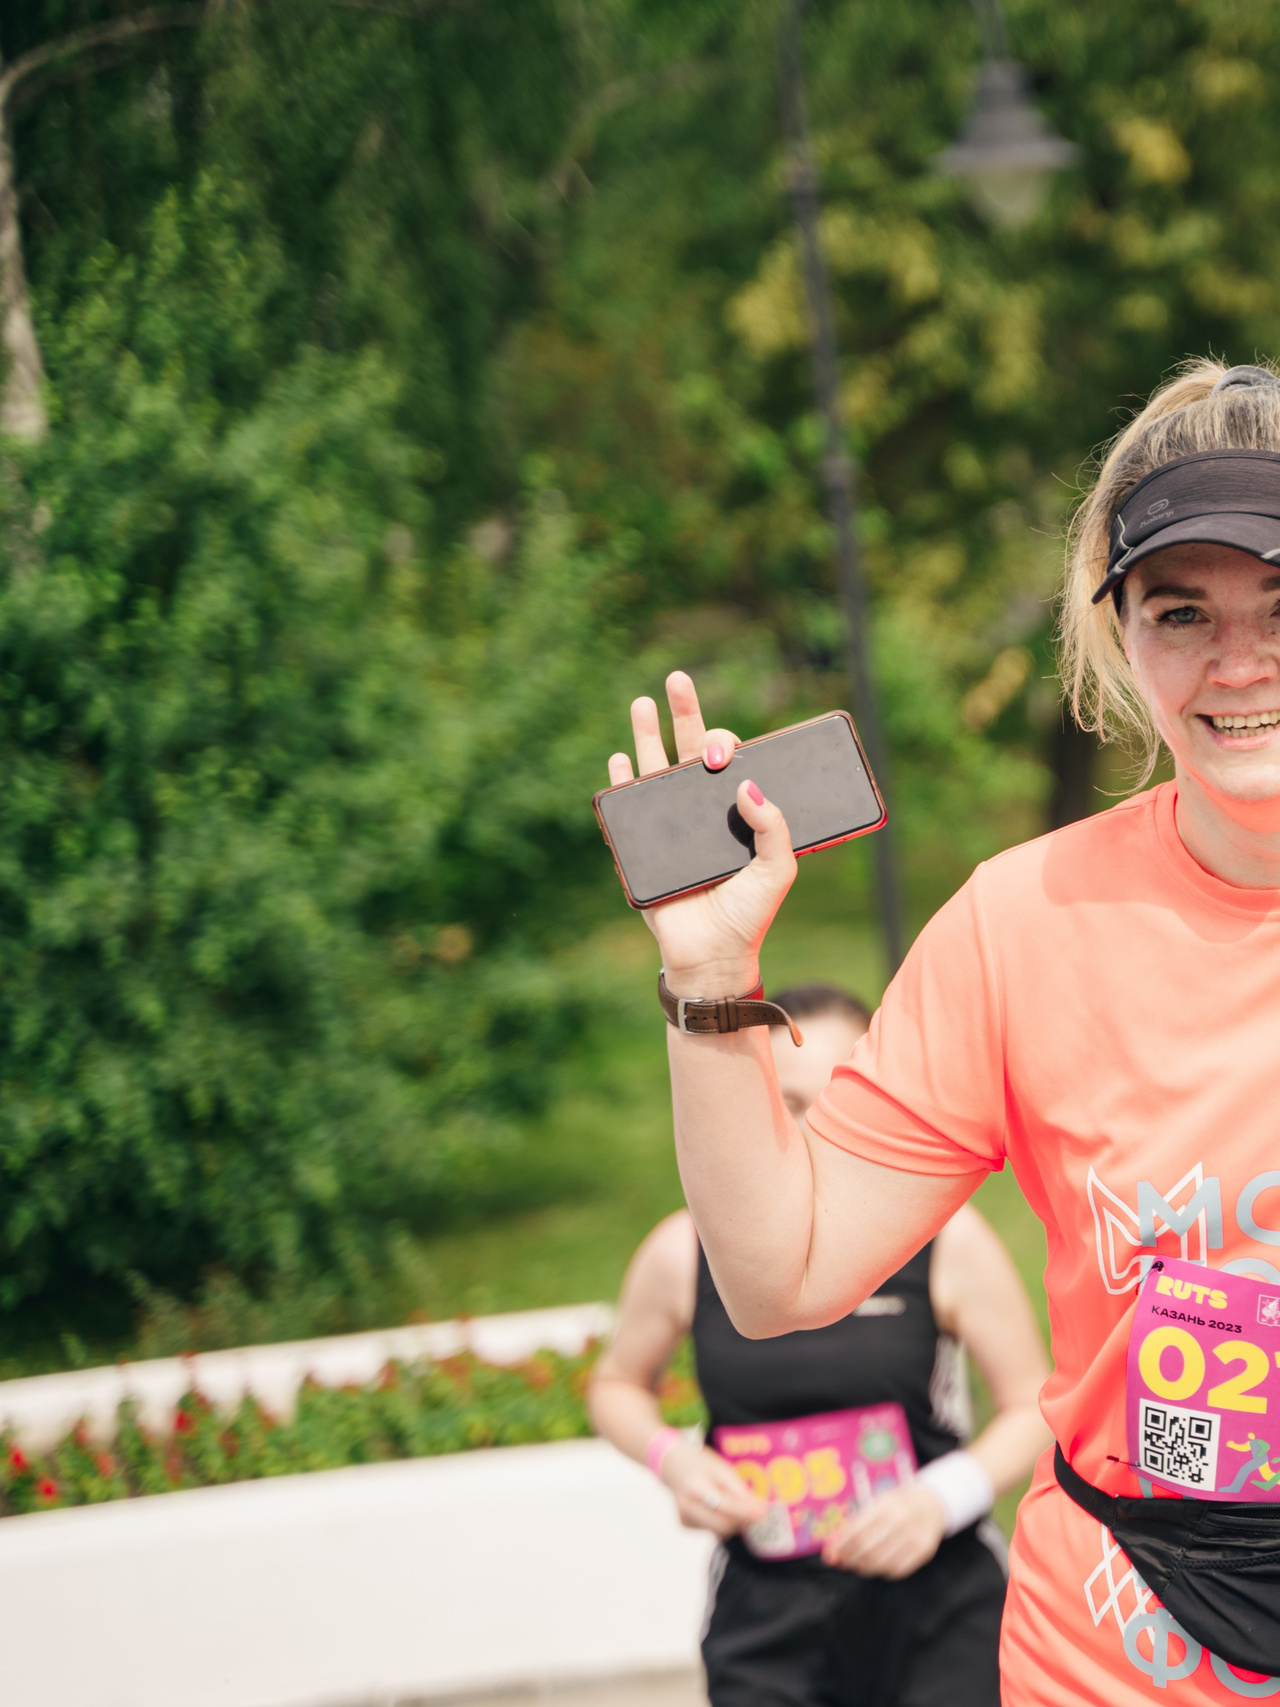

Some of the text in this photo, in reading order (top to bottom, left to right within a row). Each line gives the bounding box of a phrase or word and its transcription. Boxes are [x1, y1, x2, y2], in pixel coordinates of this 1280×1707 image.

[1155, 1275, 1228, 1309] RUTS
[1151, 1305, 1243, 1334] КАЗАНЬ 2023
